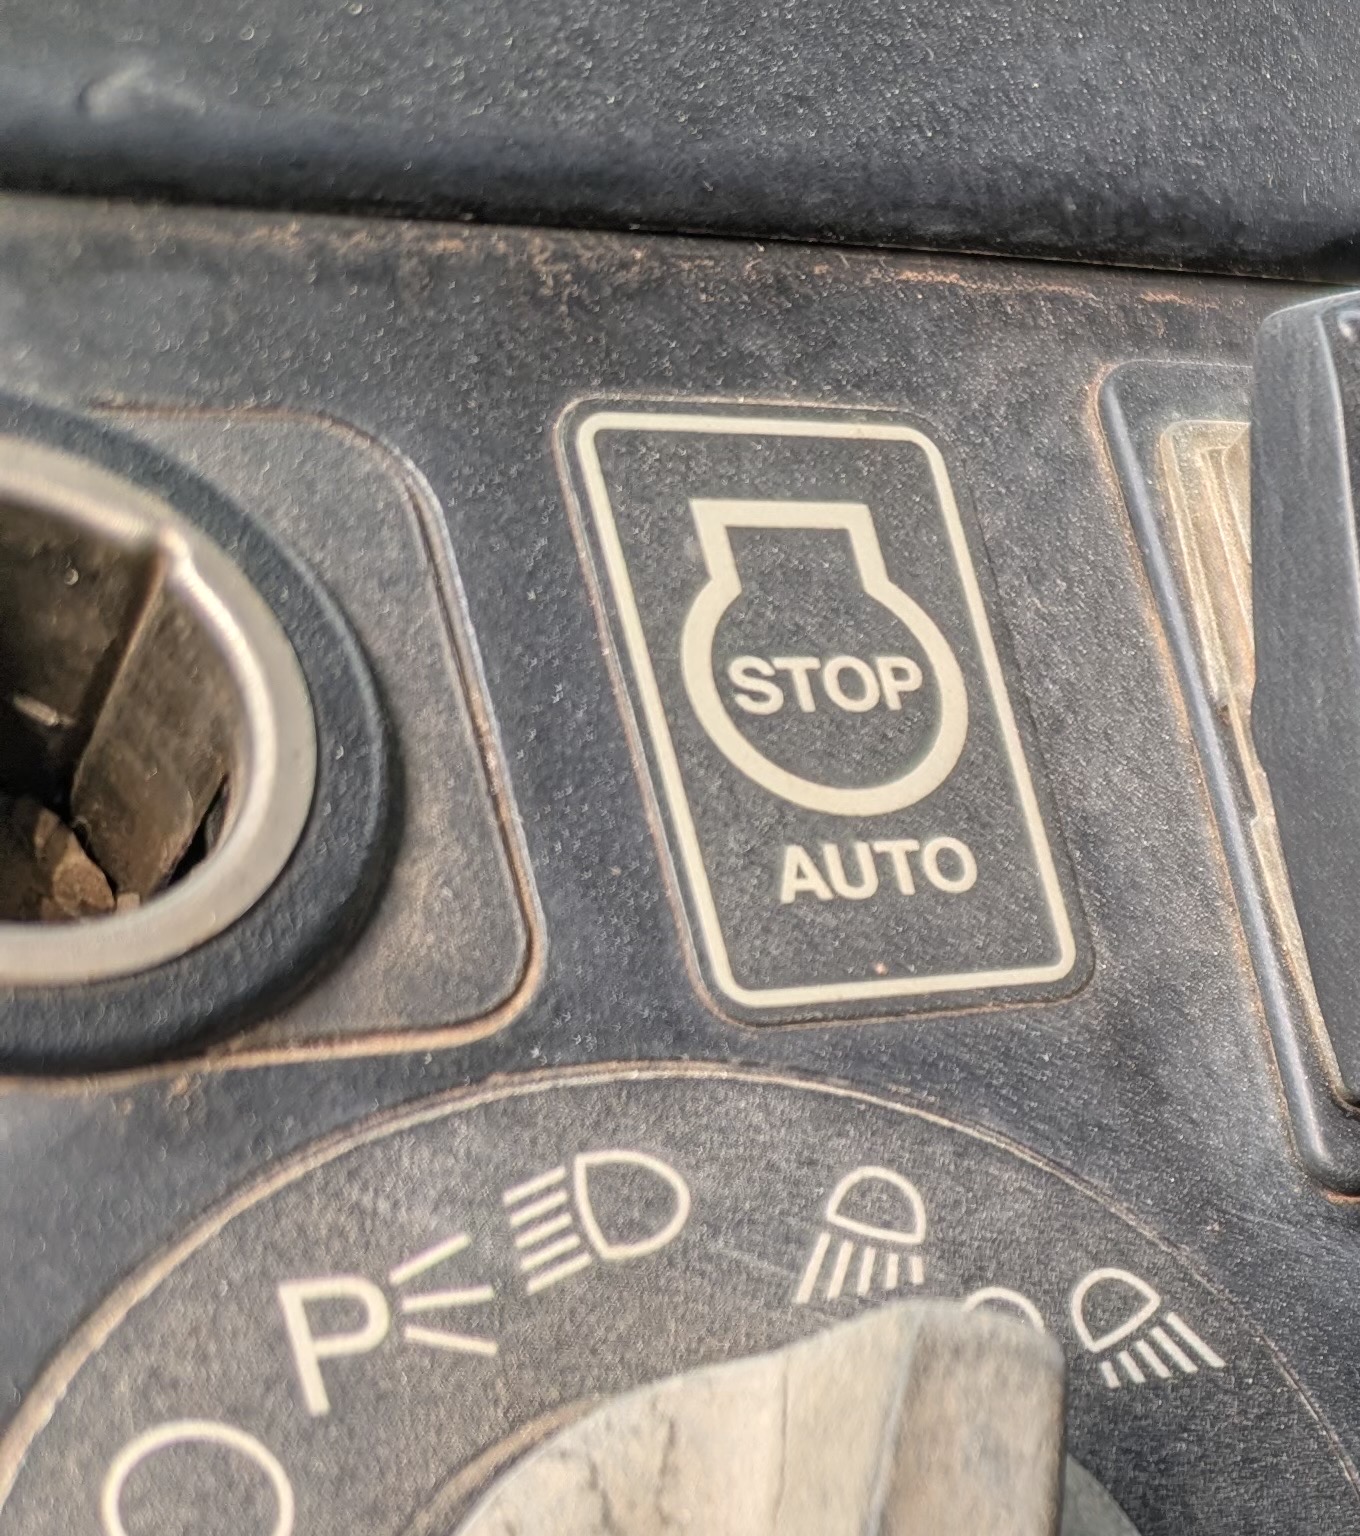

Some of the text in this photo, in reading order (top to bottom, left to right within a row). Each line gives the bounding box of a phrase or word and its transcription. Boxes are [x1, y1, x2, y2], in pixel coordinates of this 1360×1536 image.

[728, 655, 924, 714] STOP
[780, 836, 979, 904] AUTO
[278, 1274, 390, 1417] P
